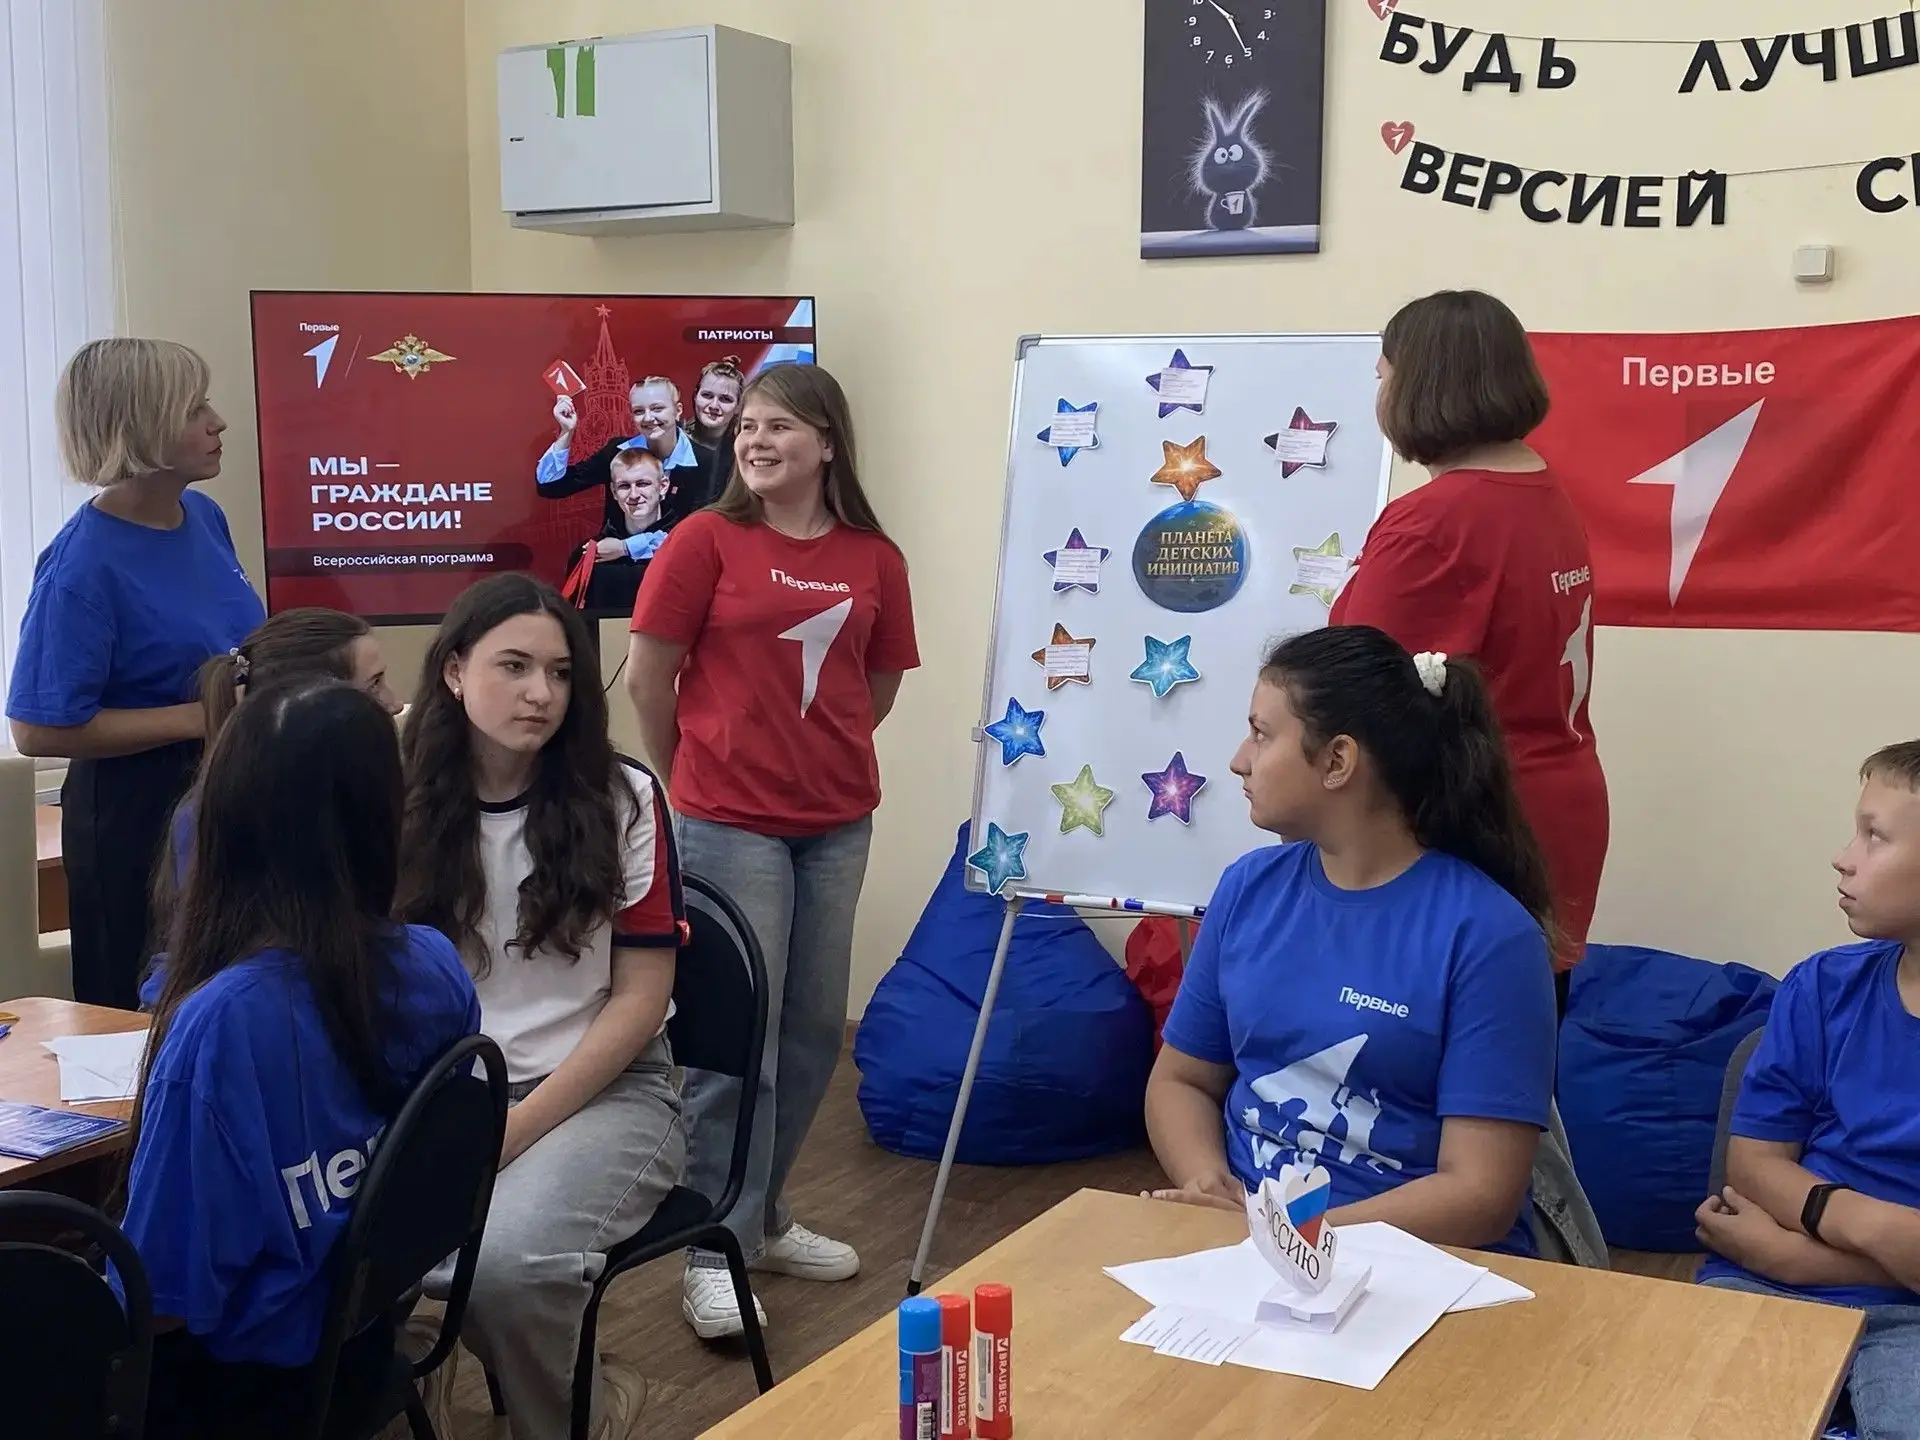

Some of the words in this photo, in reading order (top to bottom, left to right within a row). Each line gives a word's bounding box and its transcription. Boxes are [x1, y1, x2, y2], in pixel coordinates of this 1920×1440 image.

[1188, 16, 1197, 26] 9
[1263, 9, 1272, 19] 3
[1193, 36, 1201, 46] 8
[1257, 30, 1266, 40] 4
[1206, 50, 1215, 60] 7
[1224, 54, 1233, 64] 6
[1244, 47, 1252, 57] 5
[1379, 11, 1576, 92] БУДЬ
[1678, 11, 1919, 93] ЛУЧШ
[1400, 141, 1727, 227] ВЕРСИЕЙ
[299, 322, 340, 333] Первые
[698, 330, 774, 340] ПАТРИОТЫ
[1622, 356, 1776, 394] Первые
[309, 456, 368, 476] МЫ
[310, 482, 493, 506] ГРАЖДАНЕ
[312, 510, 462, 532] РОССИИ!
[1160, 530, 1233, 545] ПЛАНЕТА
[313, 555, 416, 569] Всероссийская
[420, 552, 494, 568] программа
[1156, 546, 1233, 562] ДЕТСКИХ
[1147, 561, 1240, 577] ИНИЦИАТИВ
[770, 568, 851, 593] Первые
[1339, 986, 1409, 1018] Первые
[1321, 1230, 1335, 1258] Я
[998, 1351, 1008, 1413] BRAUBERG
[957, 1363, 968, 1426] BRAUBERG
